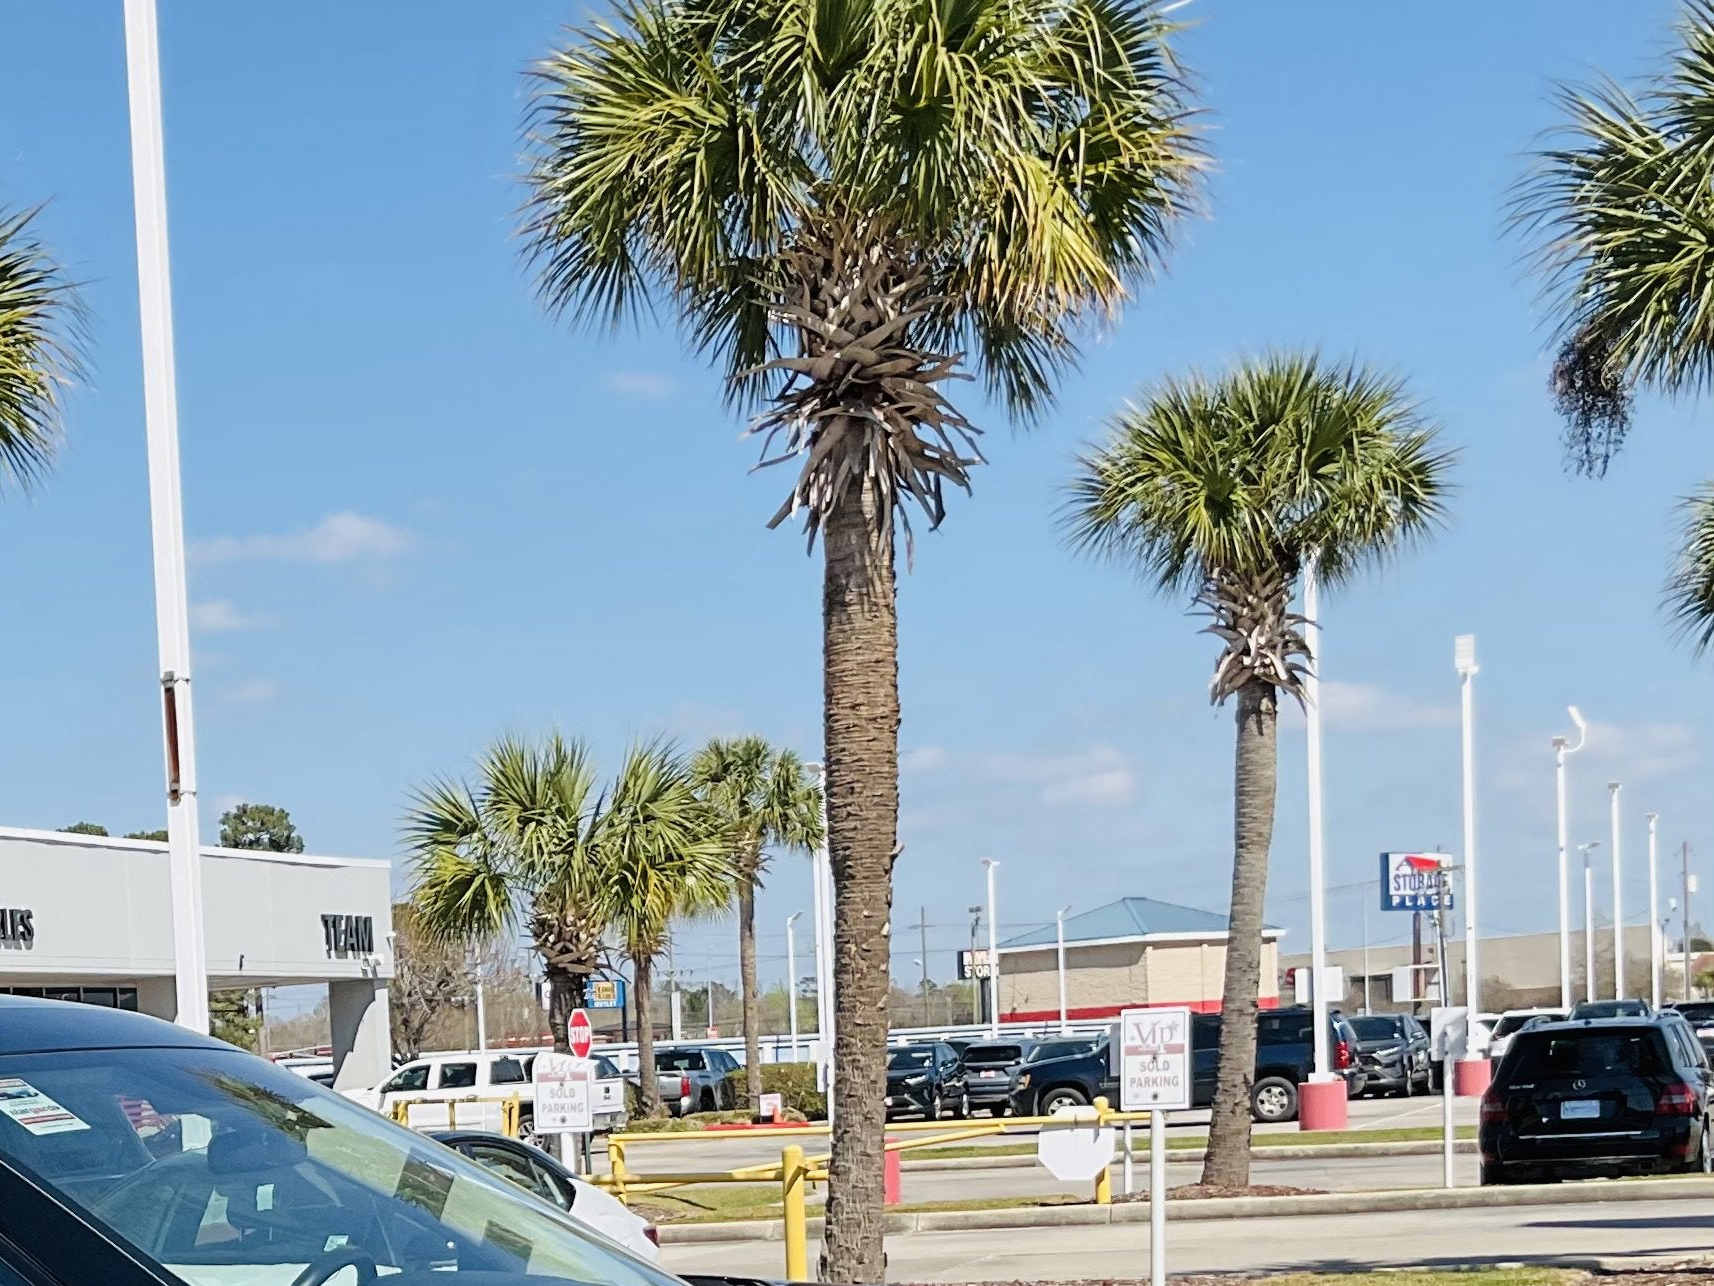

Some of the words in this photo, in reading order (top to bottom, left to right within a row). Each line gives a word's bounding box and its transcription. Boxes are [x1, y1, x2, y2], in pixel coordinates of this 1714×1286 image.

[1392, 895, 1451, 907] PLACE
[320, 913, 374, 953] TEAM
[570, 1026, 590, 1044] STOP
[1140, 1060, 1171, 1073] SOLD
[1129, 1075, 1180, 1089] PARKING
[549, 1087, 576, 1099] SOLD
[541, 1102, 584, 1114] PARKING
